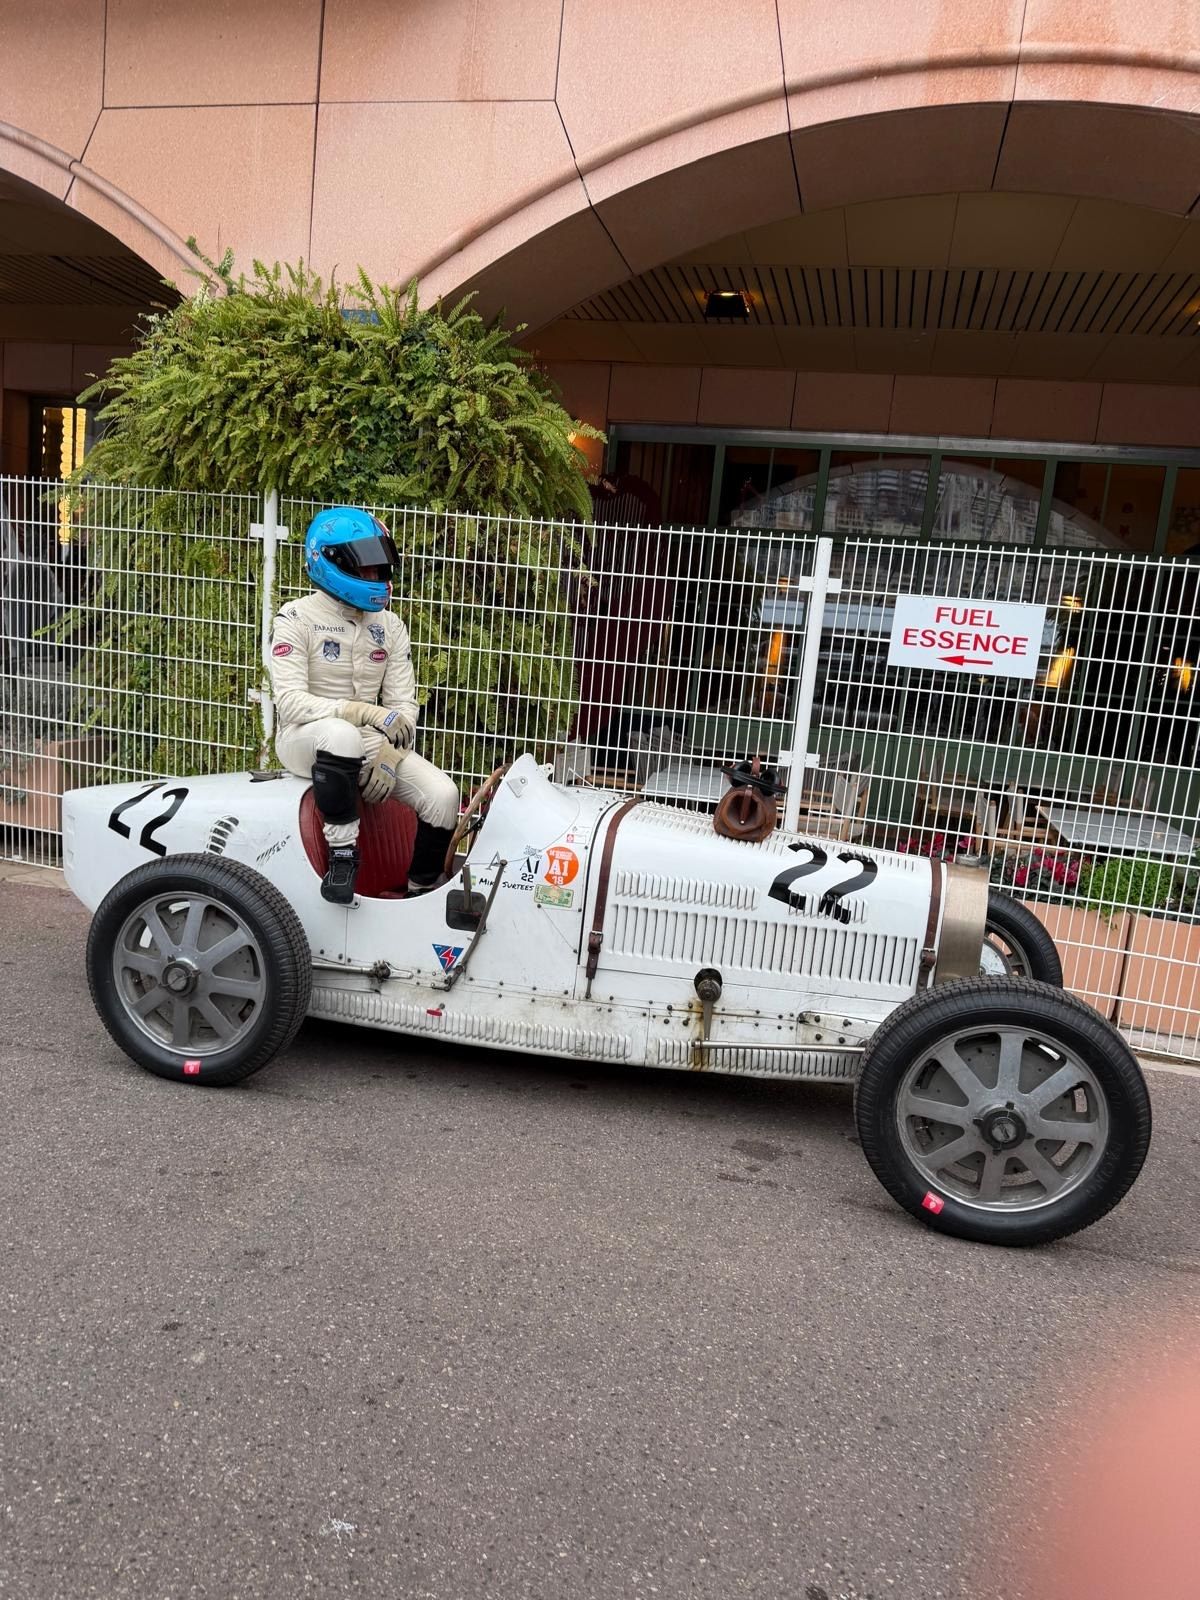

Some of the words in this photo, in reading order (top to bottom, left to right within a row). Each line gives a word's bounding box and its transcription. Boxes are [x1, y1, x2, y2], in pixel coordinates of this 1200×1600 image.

[936, 606, 1000, 628] FUEL
[902, 628, 1029, 655] ESSENCE
[108, 782, 189, 857] 22
[521, 872, 534, 883] 22
[549, 859, 569, 877] A1
[502, 881, 535, 891] SURTEES
[768, 842, 878, 925] 22
